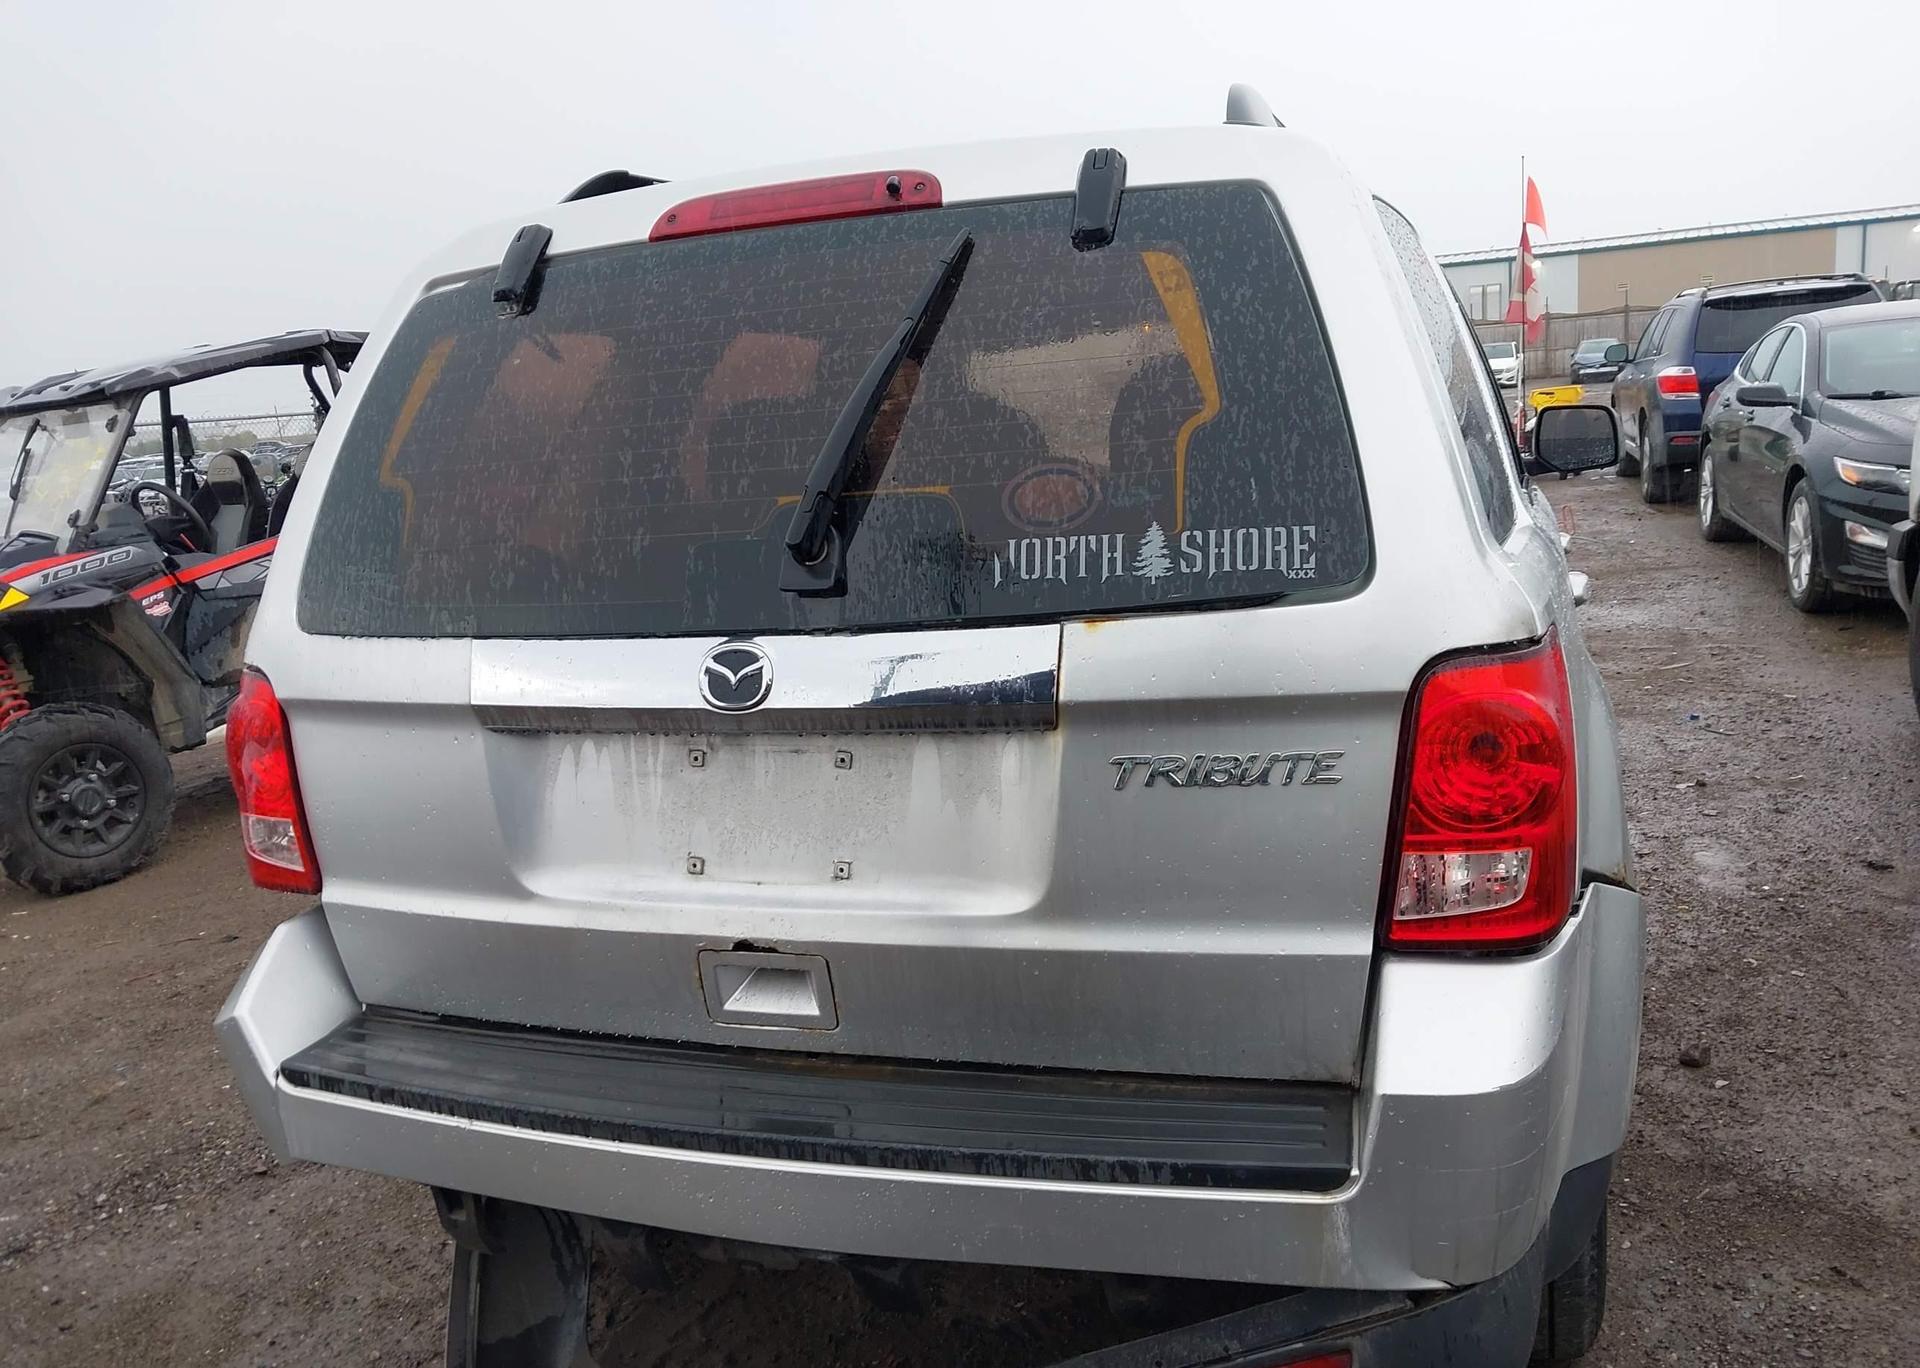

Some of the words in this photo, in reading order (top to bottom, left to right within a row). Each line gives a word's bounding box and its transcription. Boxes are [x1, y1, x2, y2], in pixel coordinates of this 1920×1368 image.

[39, 546, 134, 586] 1000
[1178, 525, 1317, 580] SHORE
[142, 591, 165, 606] EPS
[1109, 750, 1346, 790] TRIBUTE
